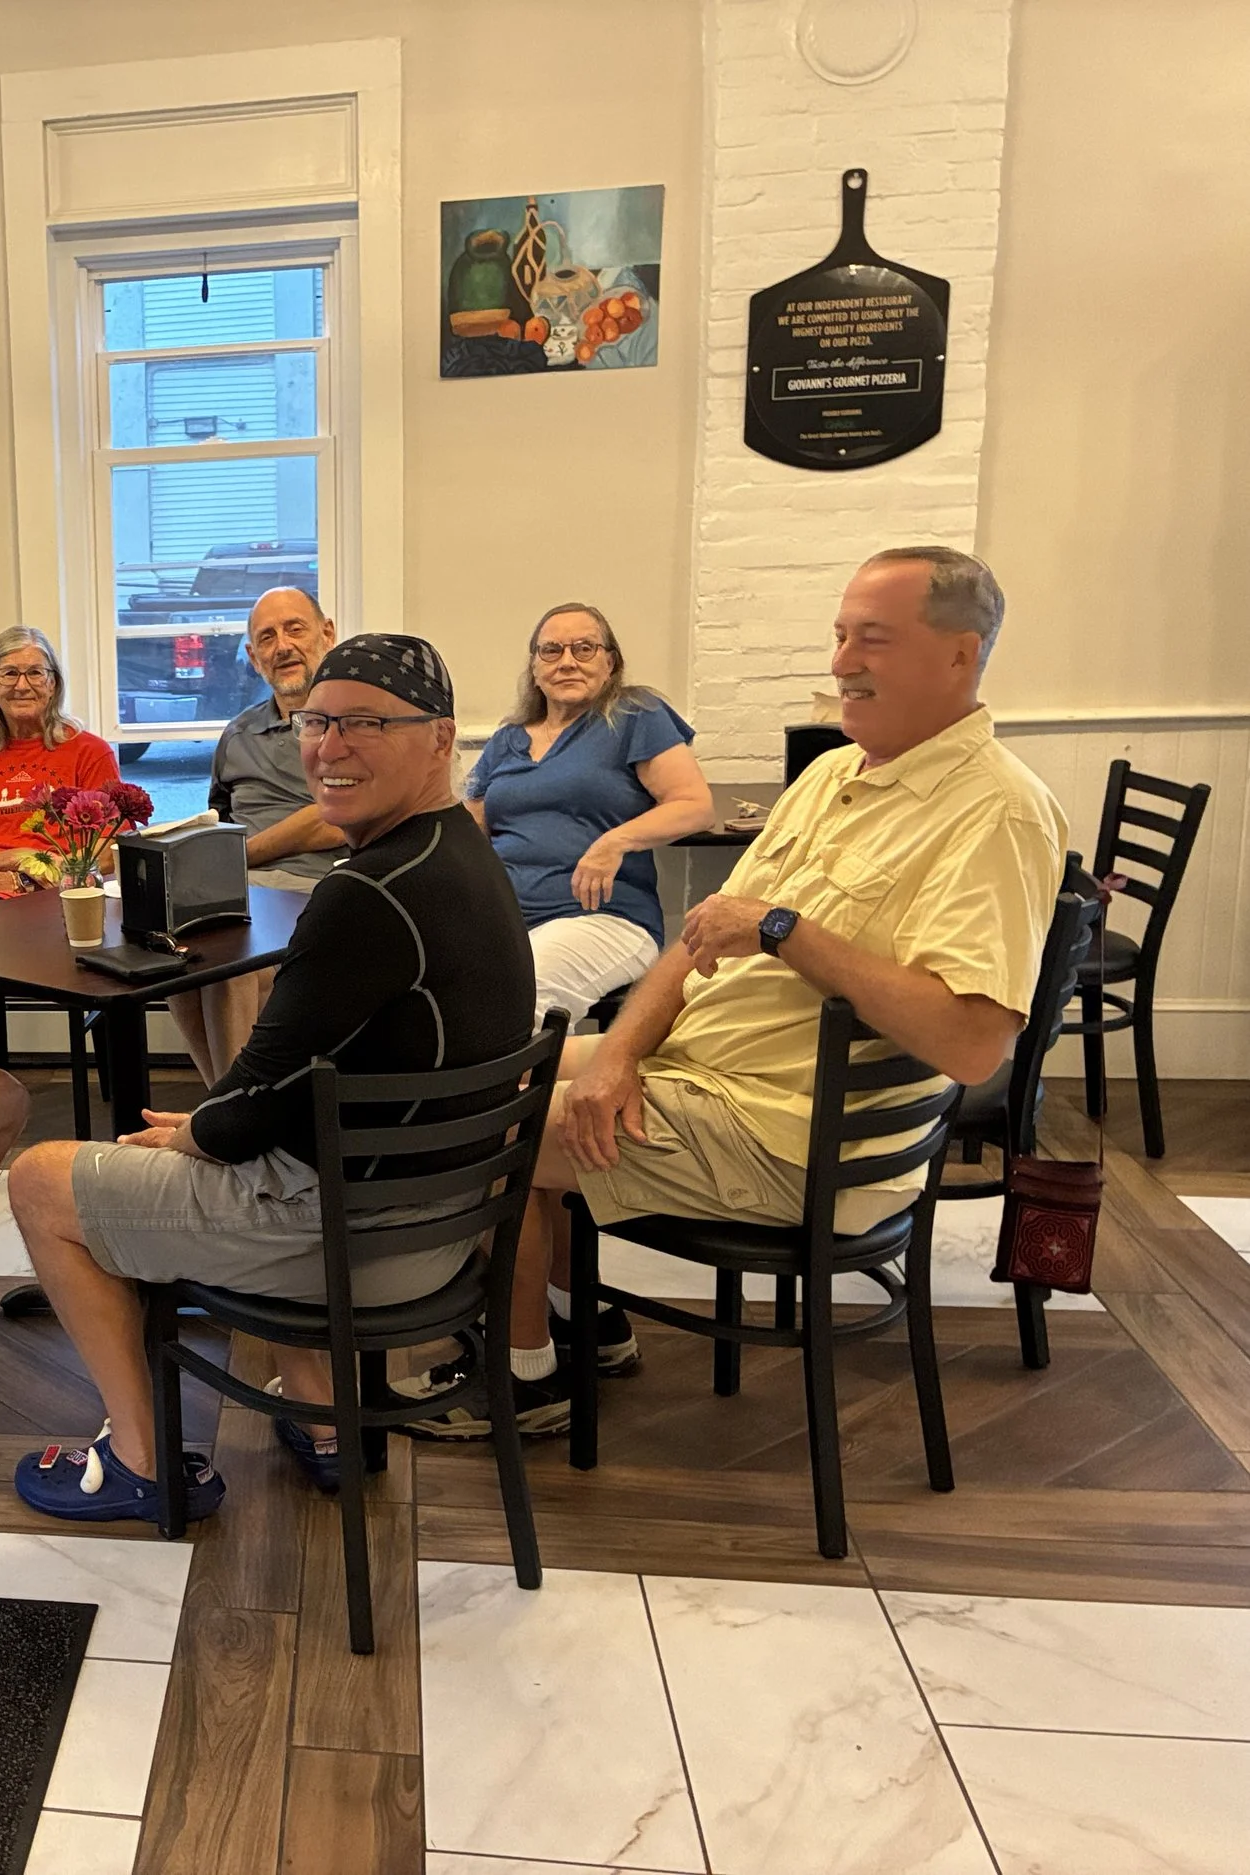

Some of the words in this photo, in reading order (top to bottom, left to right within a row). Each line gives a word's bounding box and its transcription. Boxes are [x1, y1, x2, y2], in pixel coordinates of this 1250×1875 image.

[786, 303, 796, 313] AT
[797, 302, 813, 312] OUR
[814, 298, 865, 311] INDEPENDENT
[866, 295, 912, 307] RESTAURANT
[778, 315, 789, 326] WE
[791, 315, 806, 325] ARE
[807, 312, 849, 324] COMMITTED
[850, 311, 859, 321] TO
[861, 310, 884, 320] USING
[885, 308, 904, 319] ONLY
[905, 307, 919, 317] THE
[792, 325, 822, 338] HIGHEST
[823, 324, 856, 336] QUALITY
[856, 321, 904, 333] INGREDIENTS
[820, 338, 831, 348] ON
[832, 337, 848, 347] OUR
[787, 377, 832, 391] GIOVANNI'S
[833, 375, 870, 388] GOURMET
[872, 372, 907, 386] PIZZERIA
